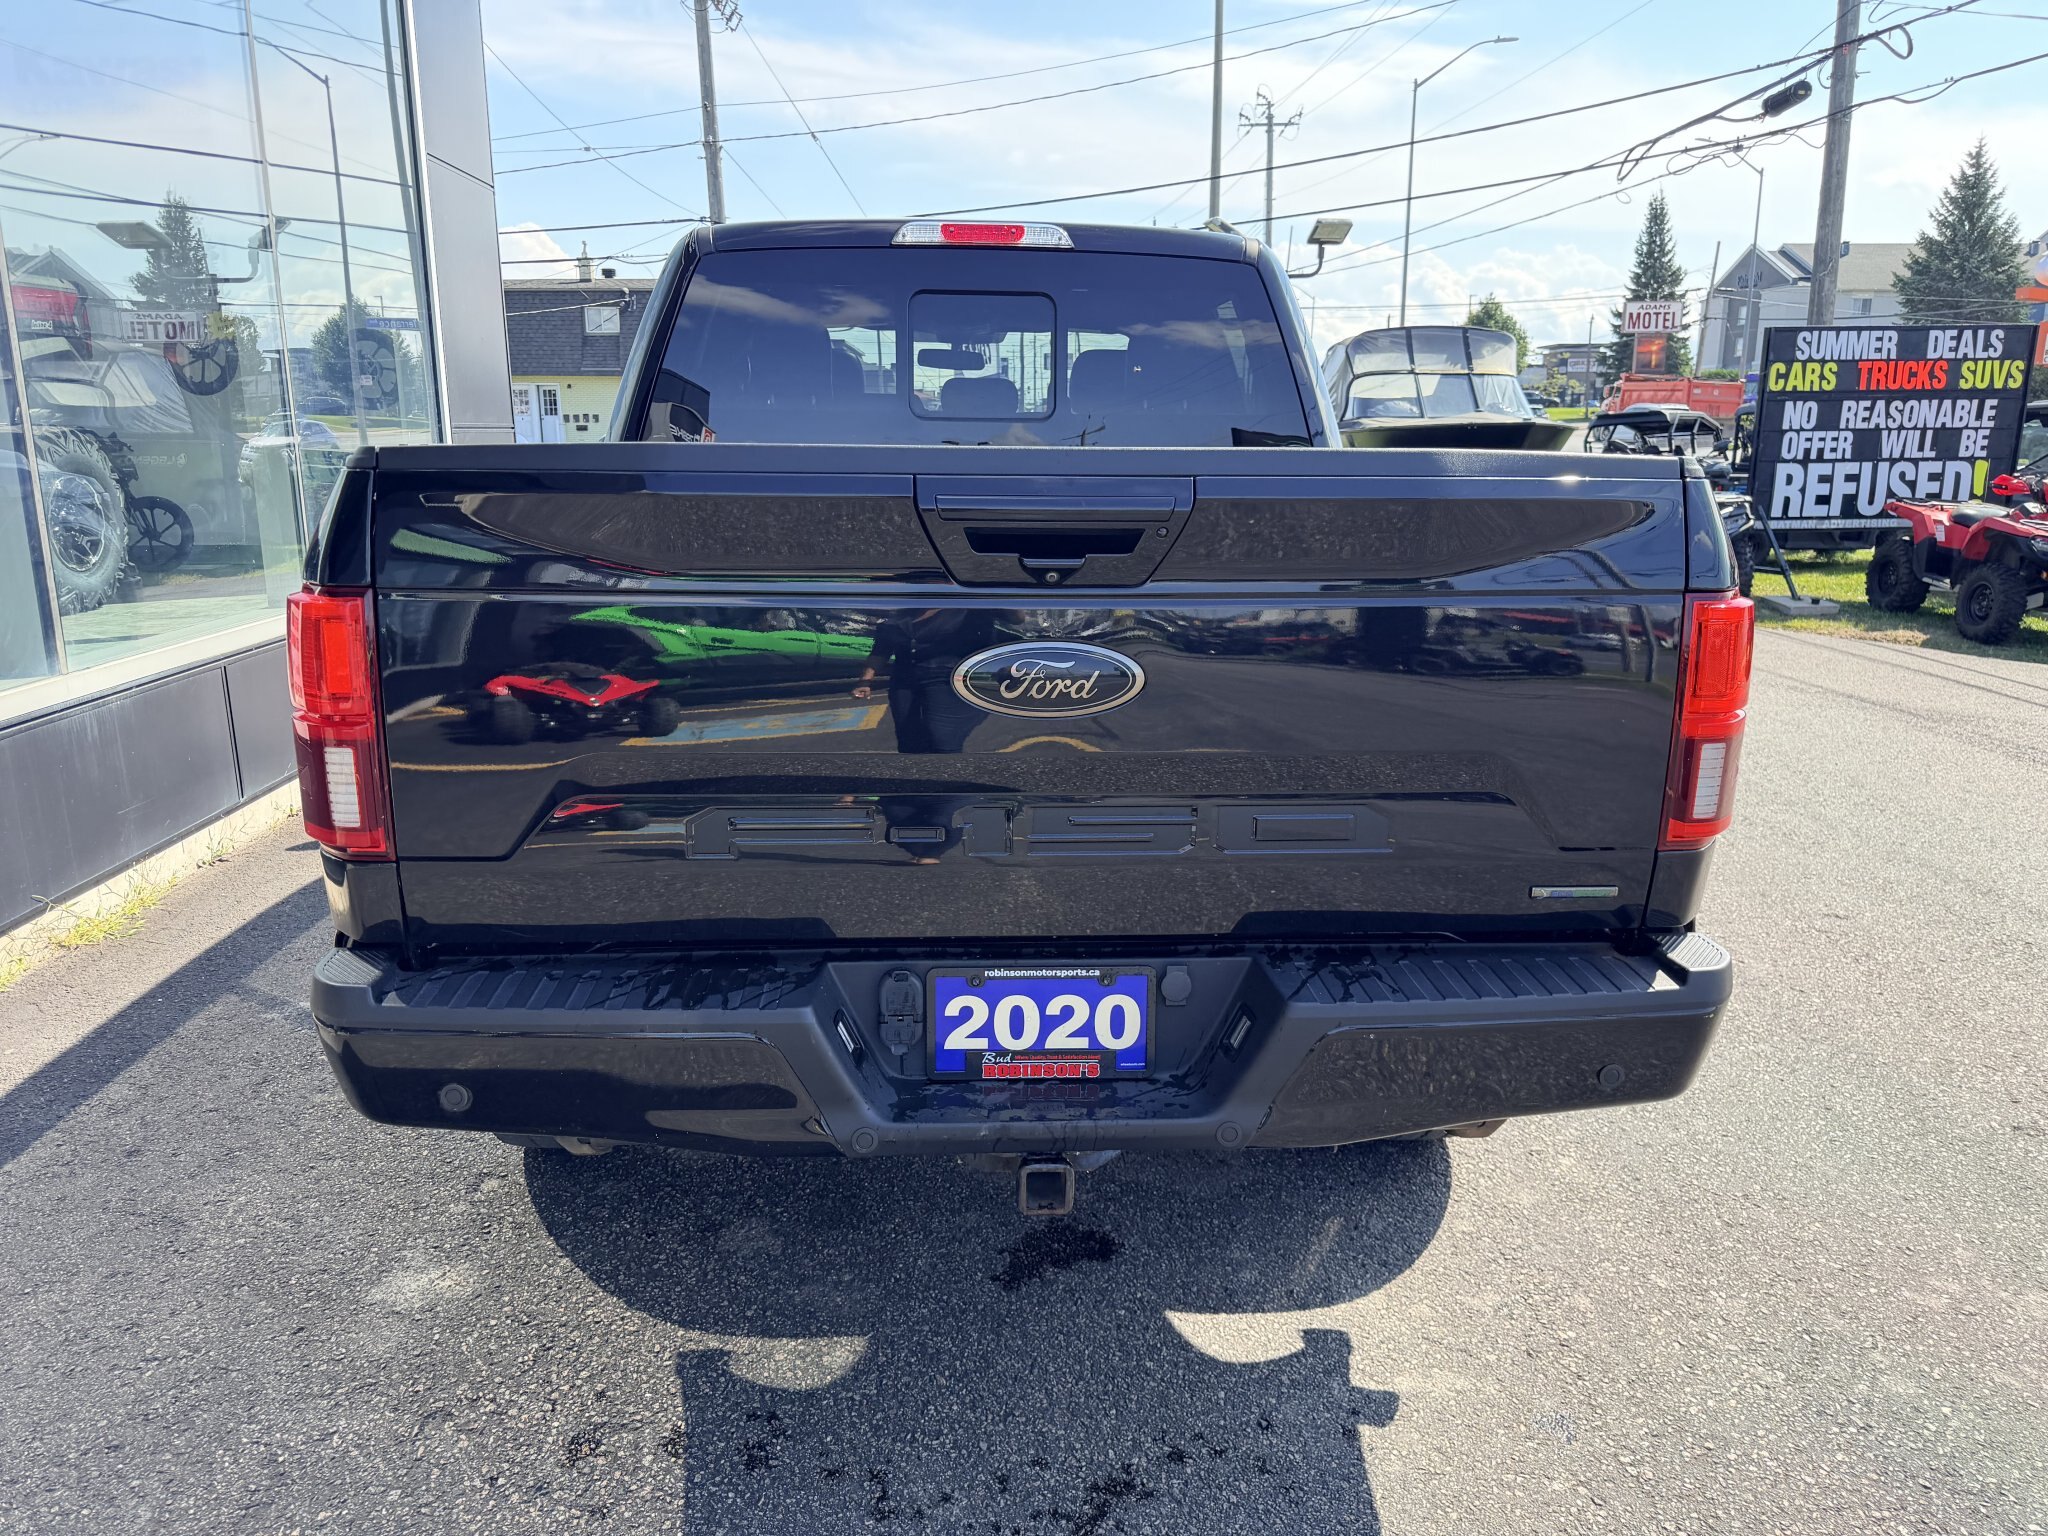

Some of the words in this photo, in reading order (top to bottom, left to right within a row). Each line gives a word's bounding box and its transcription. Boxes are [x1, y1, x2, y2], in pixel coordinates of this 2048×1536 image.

[1628, 312, 1678, 329] MOTEL
[1796, 330, 1899, 361] SUMMER
[1927, 329, 2005, 359] DEALS
[1768, 362, 1838, 392] CARS
[1858, 360, 1948, 391] TRUCKS
[1959, 359, 2025, 390] SUVS
[1782, 401, 1818, 430] NO
[1839, 399, 1999, 430] REASONABLE
[1781, 430, 1854, 460] OFFER
[1881, 429, 1936, 459] WILL
[1958, 428, 1991, 458] BE
[1770, 459, 1990, 518] REFUSED!
[1771, 520, 1817, 529] BATMAN
[1822, 518, 1898, 528] ADVERTISING
[1000, 659, 1100, 699] Ford
[984, 968, 1100, 978] robinsonmotorsports.ca
[944, 994, 1141, 1050] 2020
[982, 1052, 1012, 1063] Bud
[982, 1063, 1100, 1079] ROBINSON'S
